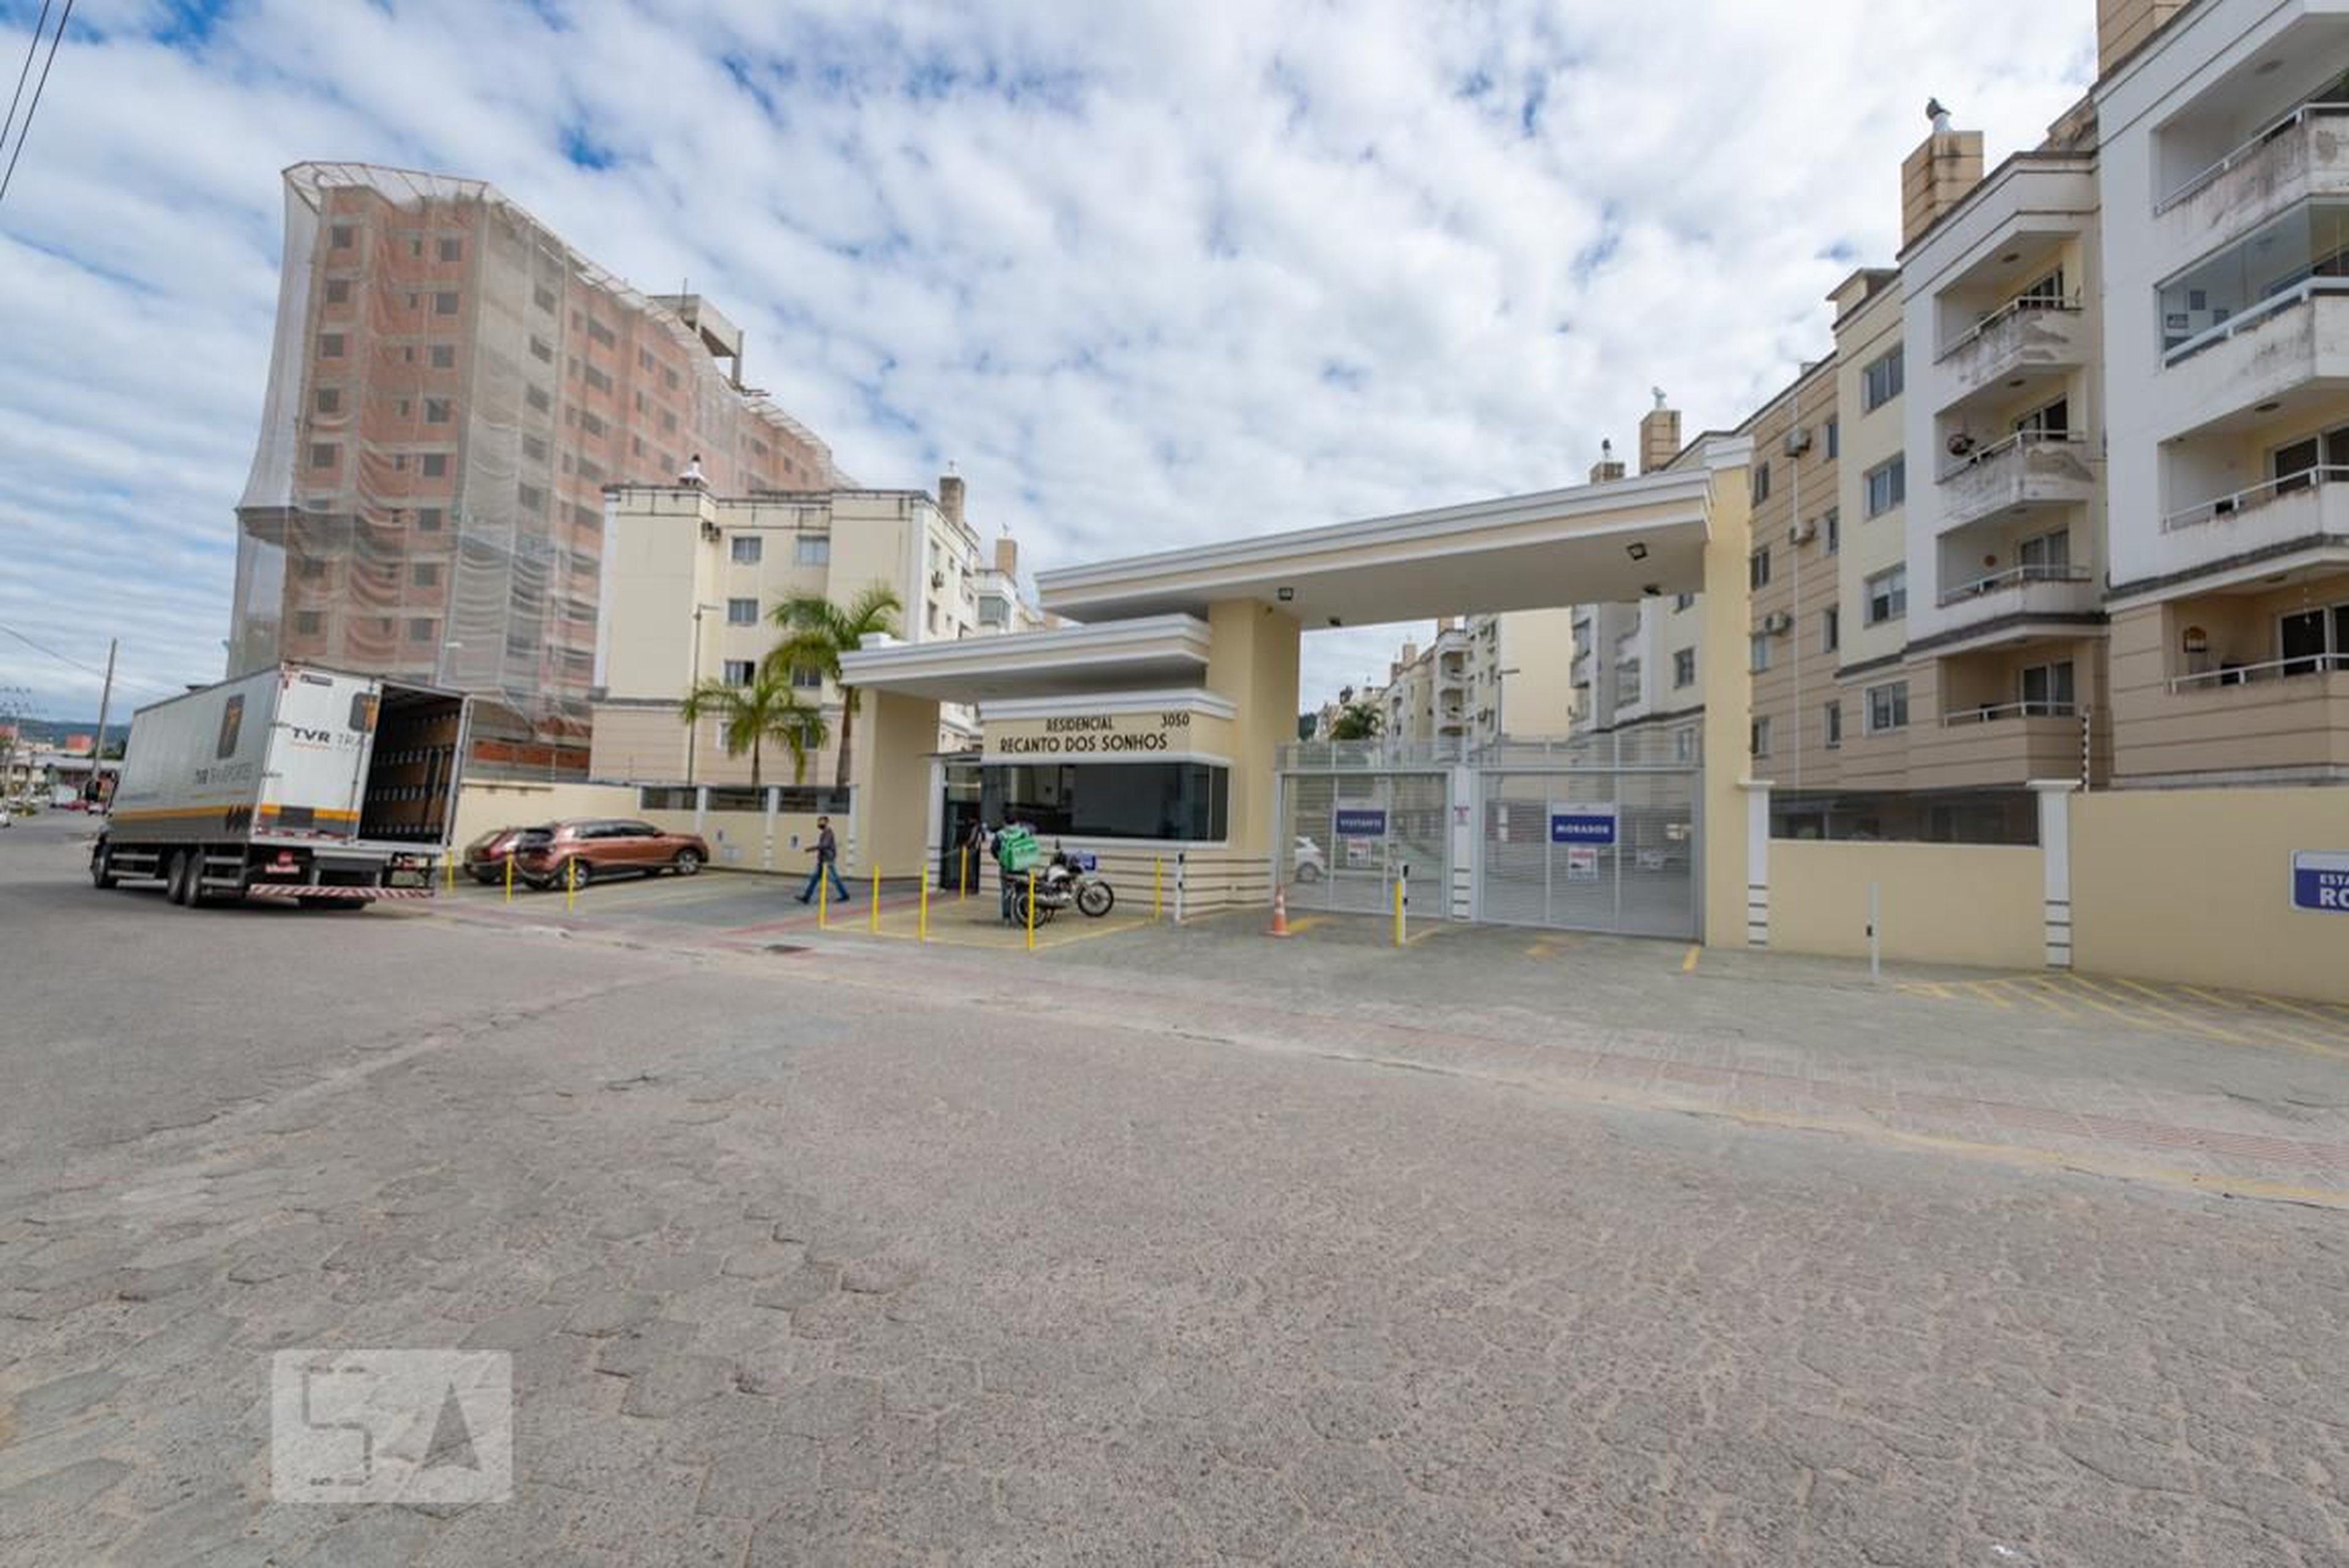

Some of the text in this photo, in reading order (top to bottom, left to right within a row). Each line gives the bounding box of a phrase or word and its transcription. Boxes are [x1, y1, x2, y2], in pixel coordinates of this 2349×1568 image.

[1046, 716, 1113, 732] RESIDENCIAL
[1162, 712, 1190, 728] 3050
[293, 727, 330, 743] TVR
[1000, 733, 1167, 753] RECANTO DOS SONHOS
[1340, 819, 1382, 827] VISITANTE
[1556, 825, 1609, 834] MORADOR
